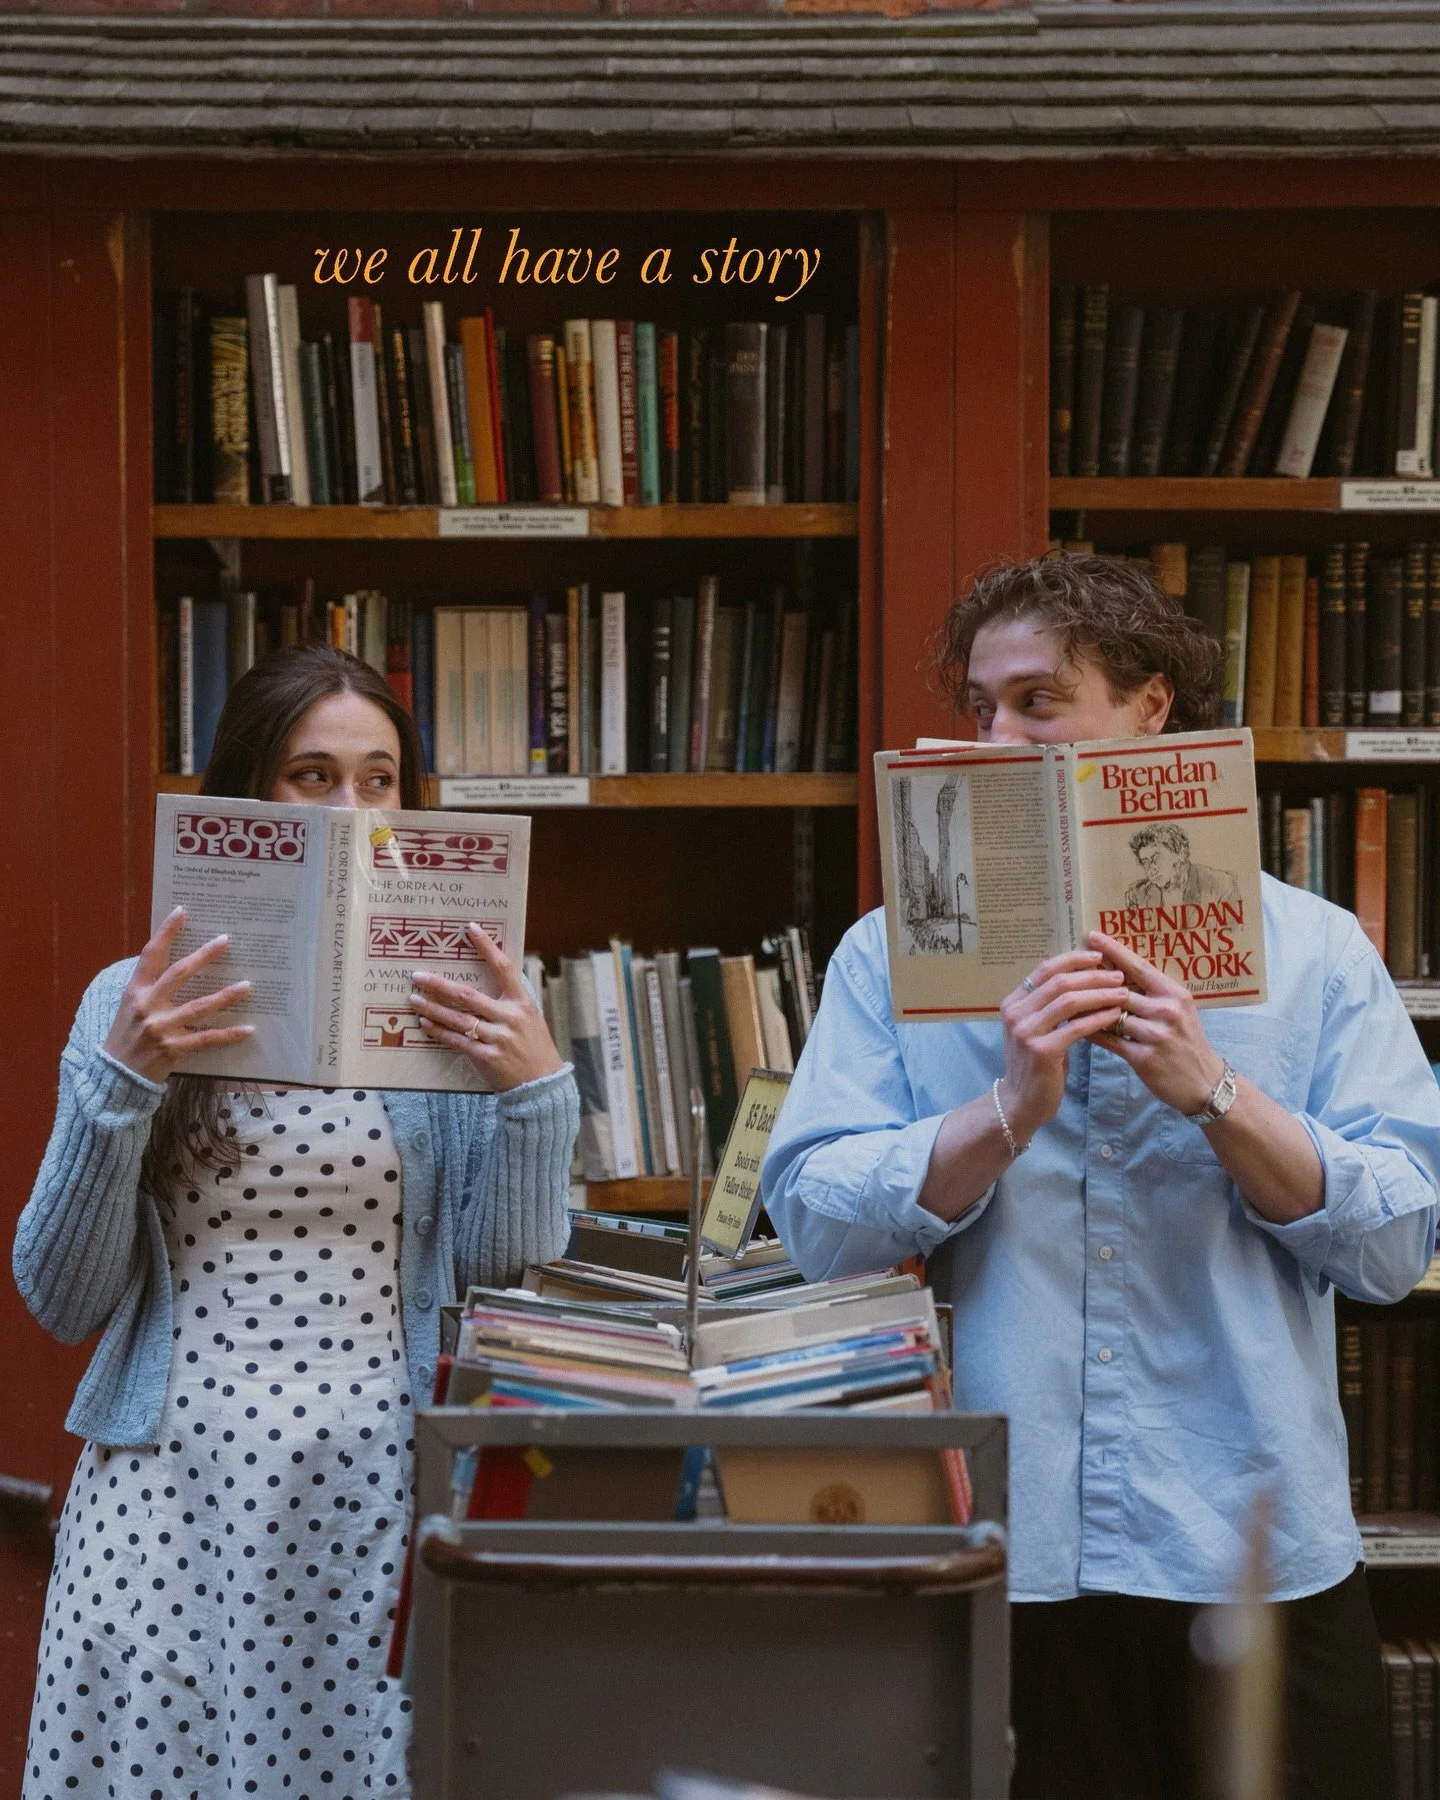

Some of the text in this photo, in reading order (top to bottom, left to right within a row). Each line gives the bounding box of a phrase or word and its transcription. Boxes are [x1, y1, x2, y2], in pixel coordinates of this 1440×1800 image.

[550, 712, 568, 738] SEA
[1101, 752, 1217, 790] Brendan
[1056, 769, 1068, 813] BRENDAN
[1119, 780, 1209, 814] Behan
[1059, 815, 1071, 853] BEHAN'S
[211, 868, 237, 876] Elizabeth
[1062, 855, 1073, 878] NEW
[371, 879, 465, 893] THE ORDEAL OF
[1064, 879, 1074, 903] YORK
[368, 893, 509, 909] ELIZABETH VAUGHAN
[1098, 899, 1245, 936] BRENDAN
[328, 823, 350, 1067] THE ORDEAL OF ELIZABETH VAUGHAN
[365, 968, 376, 979] A
[443, 970, 482, 983] DIARY
[1174, 951, 1254, 982] YORK
[363, 982, 379, 993] OF
[383, 982, 406, 994] THE
[1205, 978, 1240, 992] Hogarth
[745, 1100, 777, 1133] $5 Each
[734, 1150, 751, 1170] Books
[723, 1175, 740, 1196] Yellow
